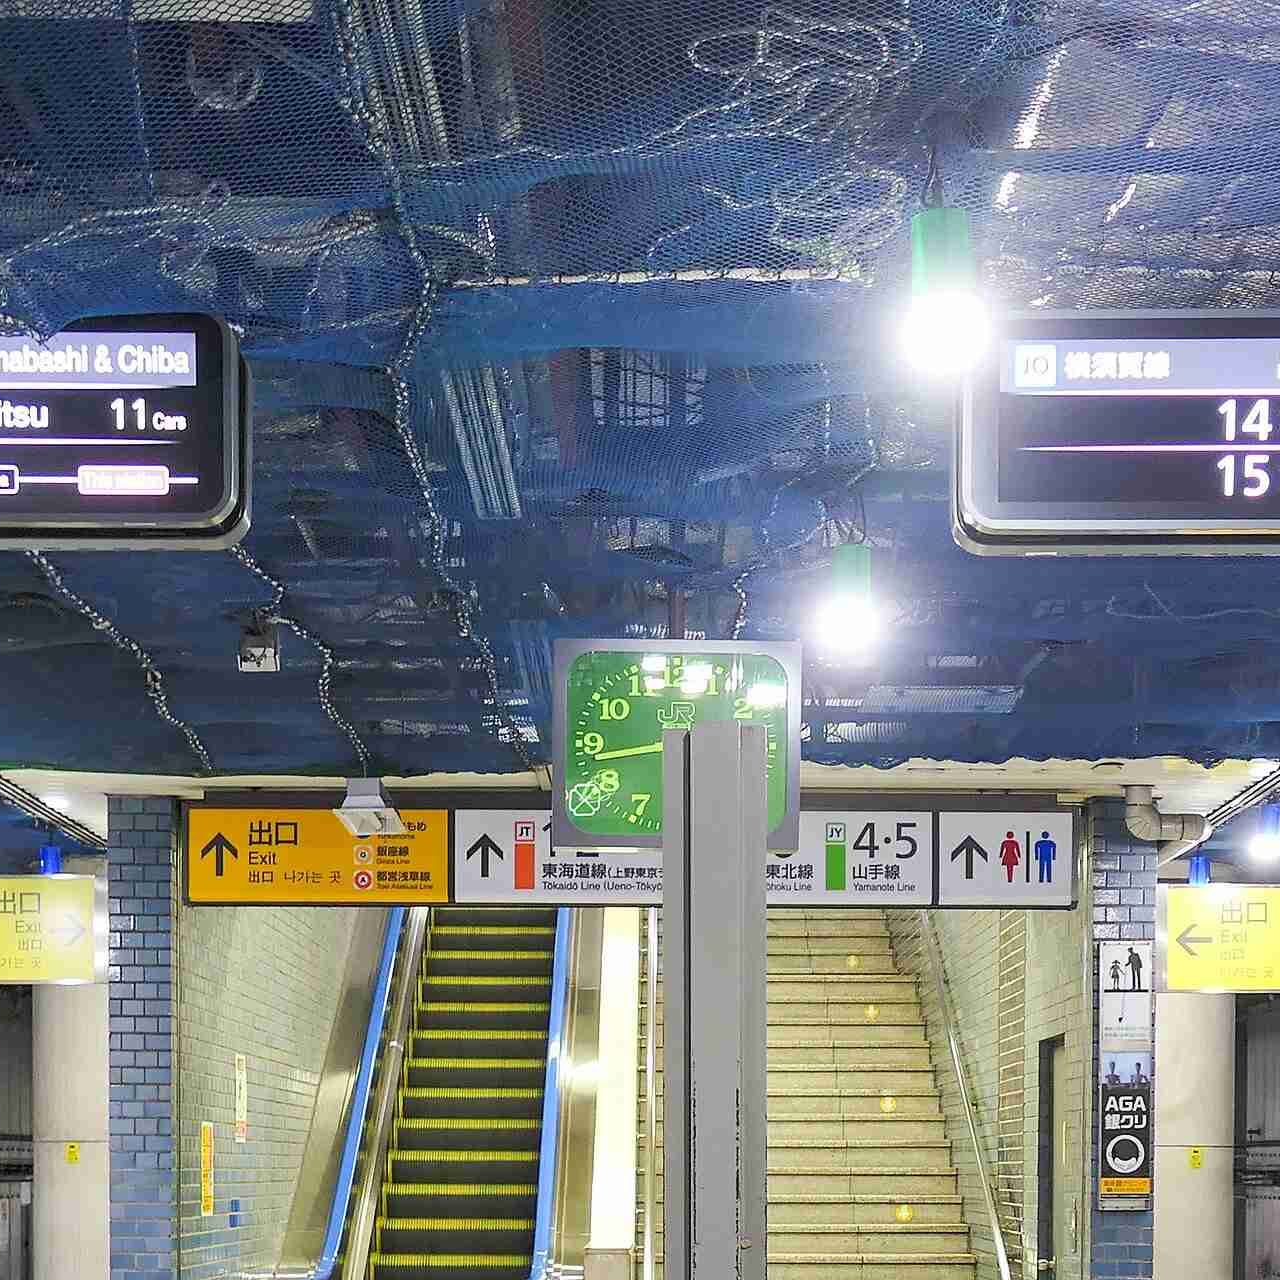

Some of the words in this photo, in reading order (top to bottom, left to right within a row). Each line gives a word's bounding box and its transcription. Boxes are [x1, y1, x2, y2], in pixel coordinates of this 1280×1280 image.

[94, 347, 113, 374] &
[118, 345, 190, 375] Chiba
[110, 398, 146, 430] 11
[153, 412, 187, 430] Cars
[599, 698, 630, 720] 10
[657, 701, 696, 724] JR
[734, 698, 753, 719] 2
[583, 733, 604, 754] 9
[599, 769, 620, 792] 8
[631, 793, 651, 816] 7
[248, 820, 298, 847] 出口
[519, 826, 531, 837] JT
[829, 828, 842, 838] JY
[248, 851, 277, 866] Exit
[248, 871, 274, 884] 出口
[852, 864, 901, 880] 山手線
[581, 881, 601, 891] Line
[794, 882, 813, 893] Line
[853, 882, 894, 893] Yamanote
[896, 882, 916, 893] Line
[1222, 901, 1267, 924] 出口
[16, 921, 42, 933] Exit
[1105, 1095, 1147, 1112] AGA
[1105, 1113, 1147, 1130] 銀クリ
